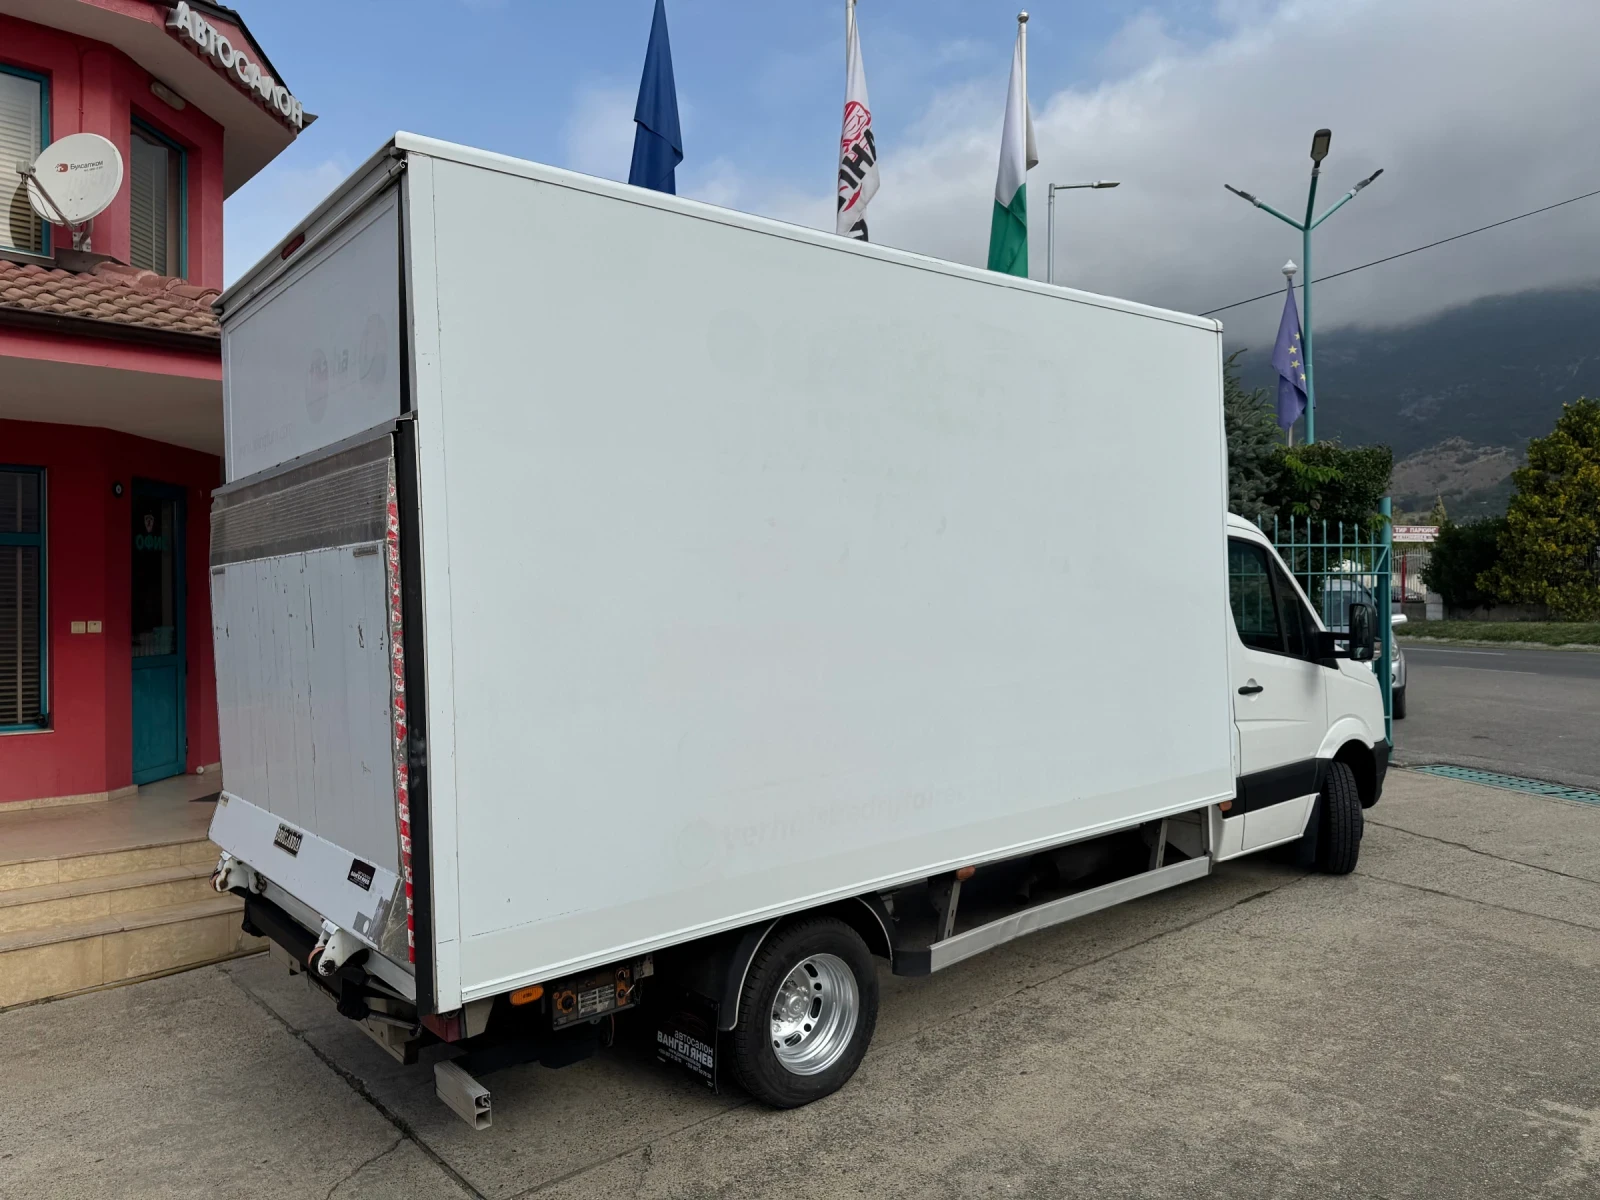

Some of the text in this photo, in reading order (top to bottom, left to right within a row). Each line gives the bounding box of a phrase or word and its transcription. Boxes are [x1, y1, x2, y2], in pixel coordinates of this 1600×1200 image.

[171, 1, 303, 129] АВТОСАЛОН
[657, 1030, 690, 1056] ВАНГЕЛ
[690, 1047, 714, 1069] ЯНЕВ
[674, 1030, 714, 1057] автосалон
